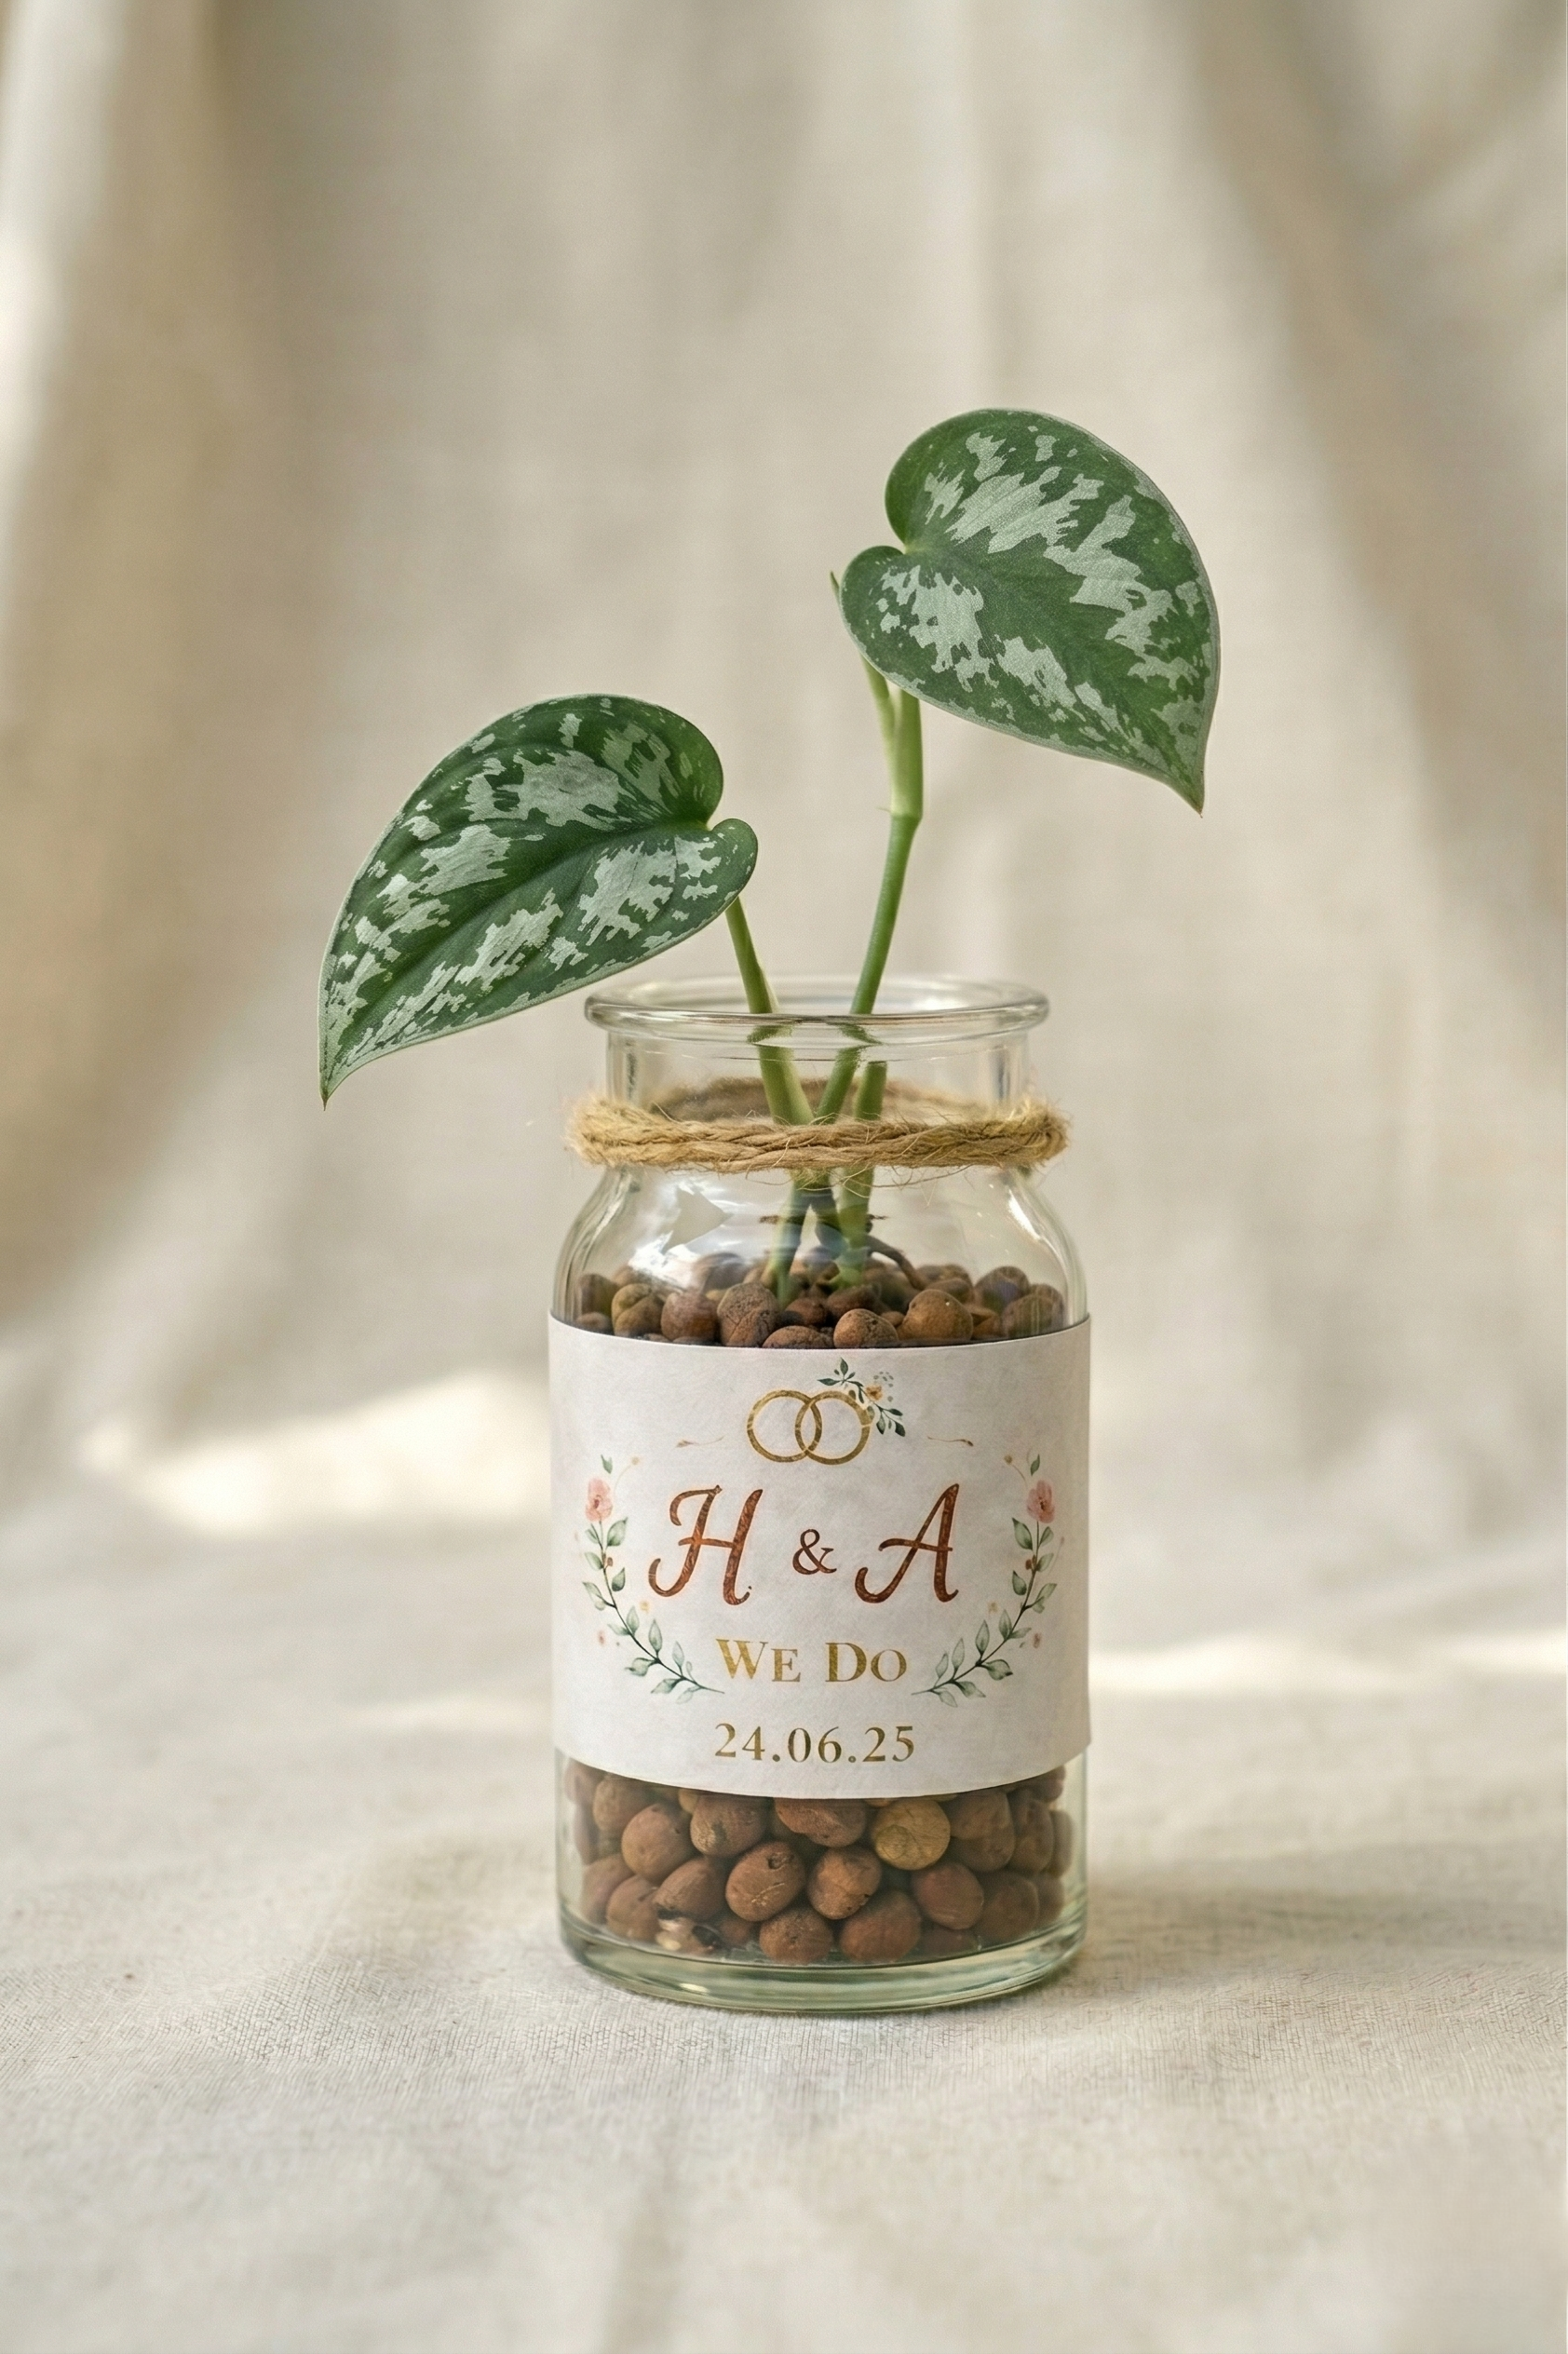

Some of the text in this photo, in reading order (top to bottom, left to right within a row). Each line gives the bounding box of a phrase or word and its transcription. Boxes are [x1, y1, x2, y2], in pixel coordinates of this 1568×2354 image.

[647, 1482, 960, 1606] H & A
[714, 1722, 915, 1765] 24.06.25
